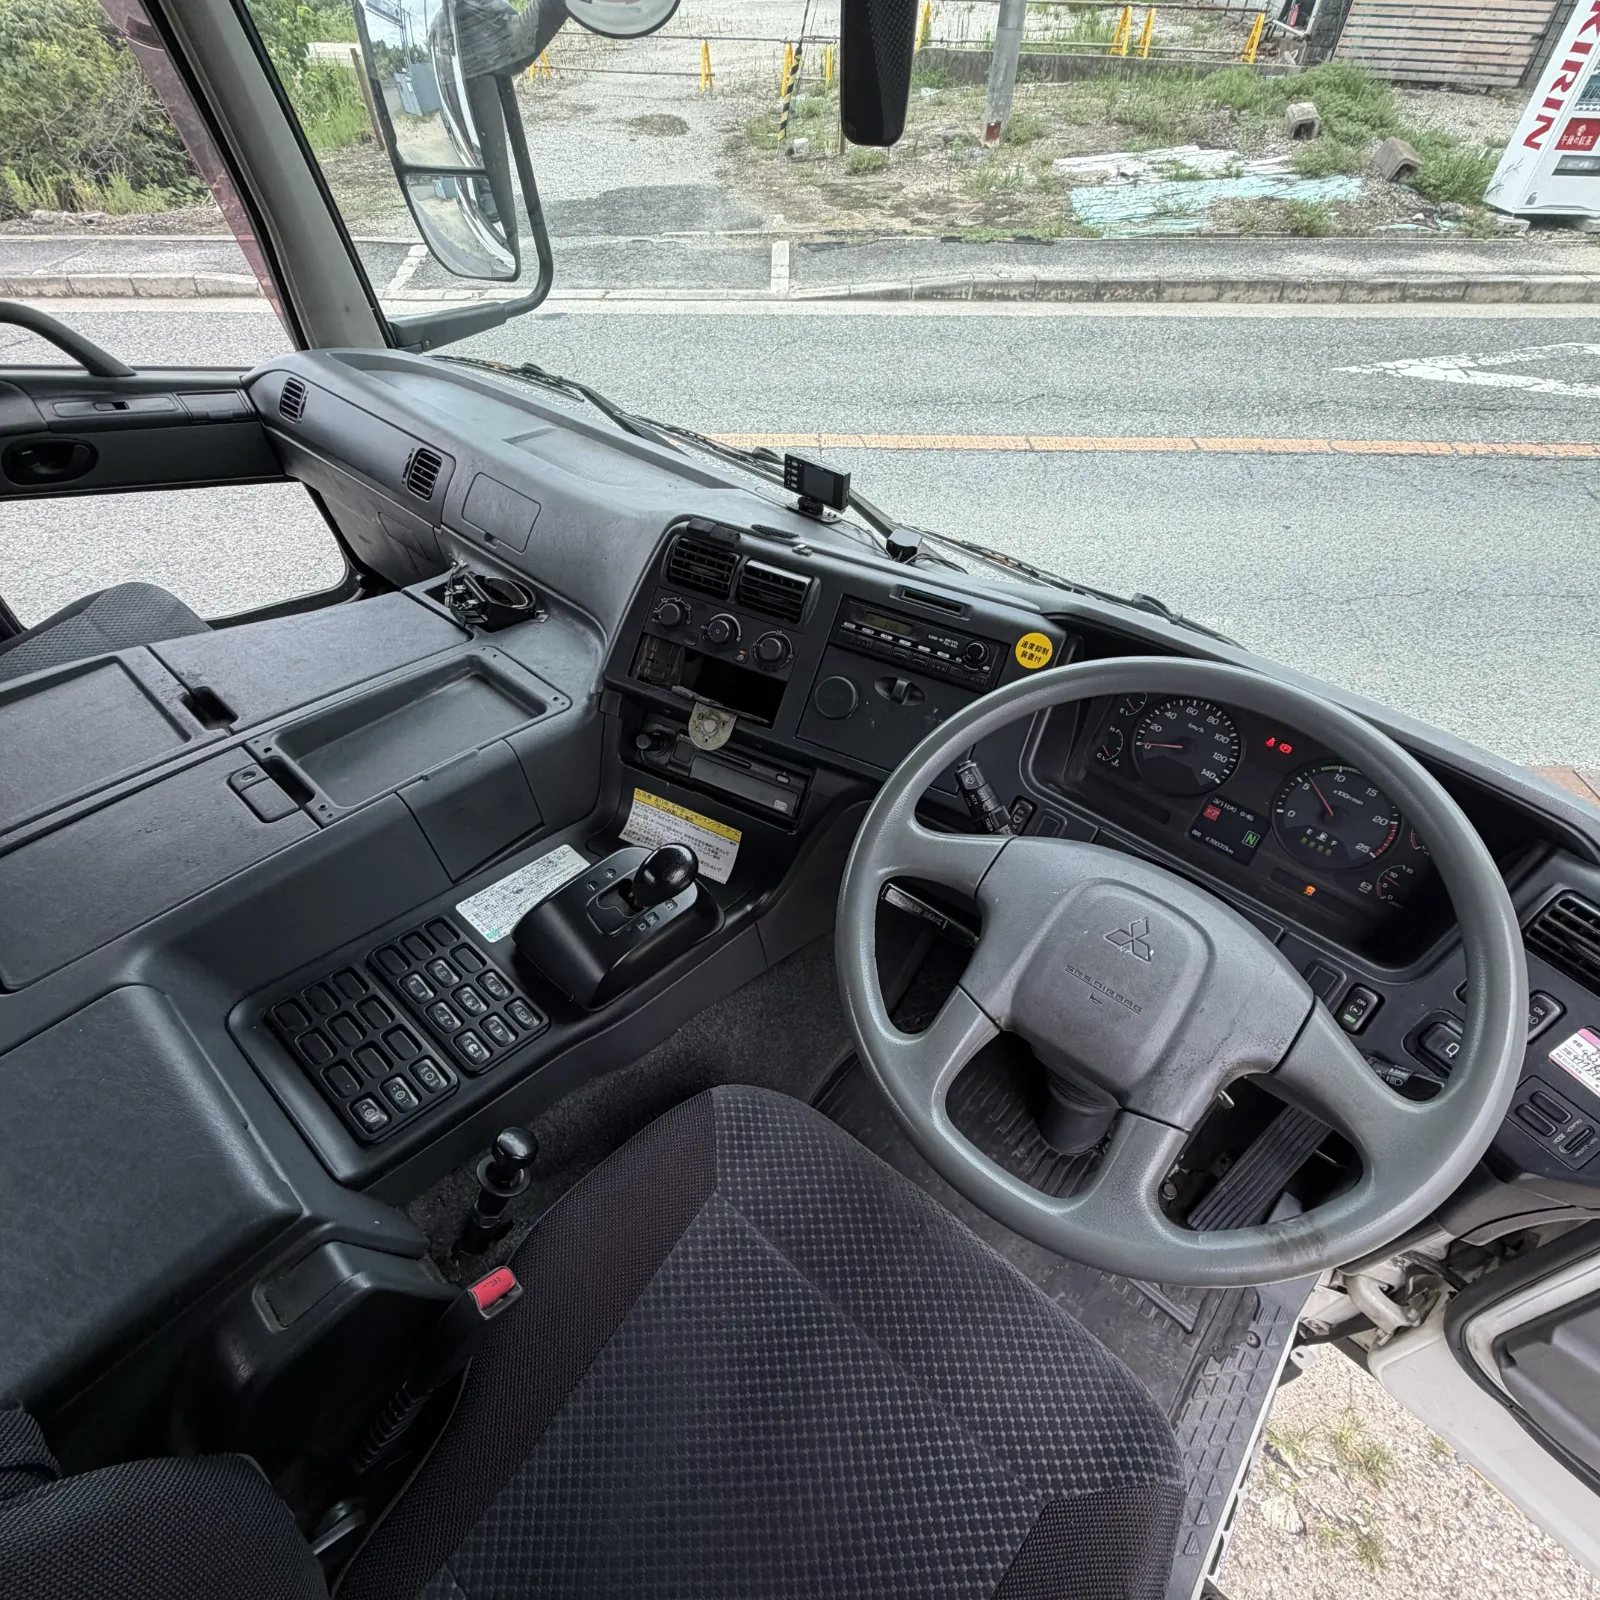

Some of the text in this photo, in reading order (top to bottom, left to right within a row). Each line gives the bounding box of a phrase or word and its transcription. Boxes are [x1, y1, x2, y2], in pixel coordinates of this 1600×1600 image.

[1523, 0, 1600, 150] KIRIN
[1561, 134, 1593, 146] 午後の紅茶
[1020, 640, 1050, 656] 速度抑制
[1020, 650, 1042, 664] 装置付
[1165, 711, 1177, 720] 40
[1186, 706, 1198, 716] 60
[1206, 715, 1220, 725] 80
[1150, 723, 1163, 733] 20
[1188, 722, 1205, 734] km/h
[1214, 733, 1230, 744] 100
[1212, 752, 1228, 763] 120
[1201, 768, 1217, 780] 140
[1333, 774, 1346, 783] 10
[1302, 783, 1311, 791] 5
[1365, 787, 1379, 797] 15
[1206, 807, 1220, 817] ドア
[1287, 810, 1297, 818] 0
[1371, 815, 1389, 826] 20
[1245, 832, 1257, 846] N
[1355, 842, 1371, 854] 25
[1389, 871, 1398, 879] 10
[1405, 867, 1414, 875] 15
[923, 911, 943, 926] BRAKE
[1065, 965, 1143, 1013] SRS AIRBAG
[1356, 999, 1367, 1007] ON
[1533, 1006, 1546, 1016] ON
[1343, 1014, 1356, 1023] OFF
